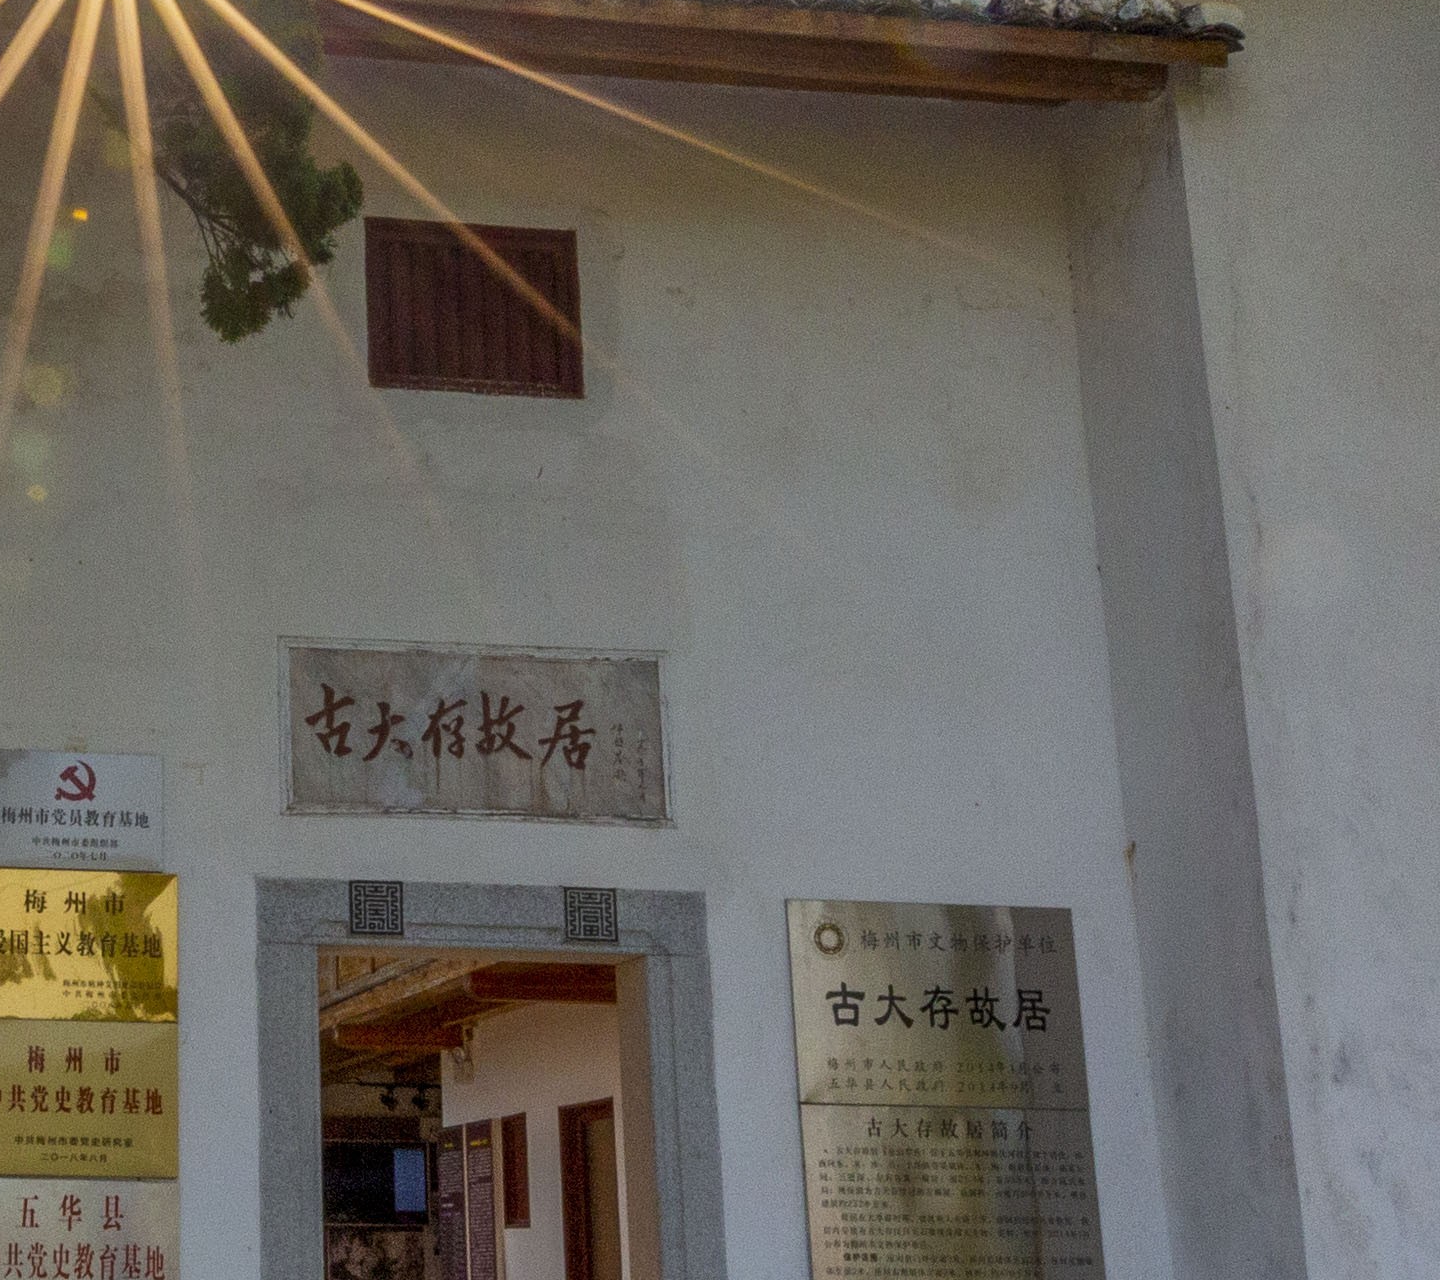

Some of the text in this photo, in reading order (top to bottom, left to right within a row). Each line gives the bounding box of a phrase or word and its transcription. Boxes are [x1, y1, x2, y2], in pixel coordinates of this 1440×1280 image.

[304, 682, 597, 771] 古大存故居
[1, 806, 151, 830] 梅州市党员教育基地
[23, 888, 126, 916] 梅州市
[825, 981, 1051, 1032] 古大存故居
[27, 1045, 122, 1076] 梅州市
[866, 1117, 1034, 1141] 古大存故居简介
[16, 1193, 124, 1232] 五华县
